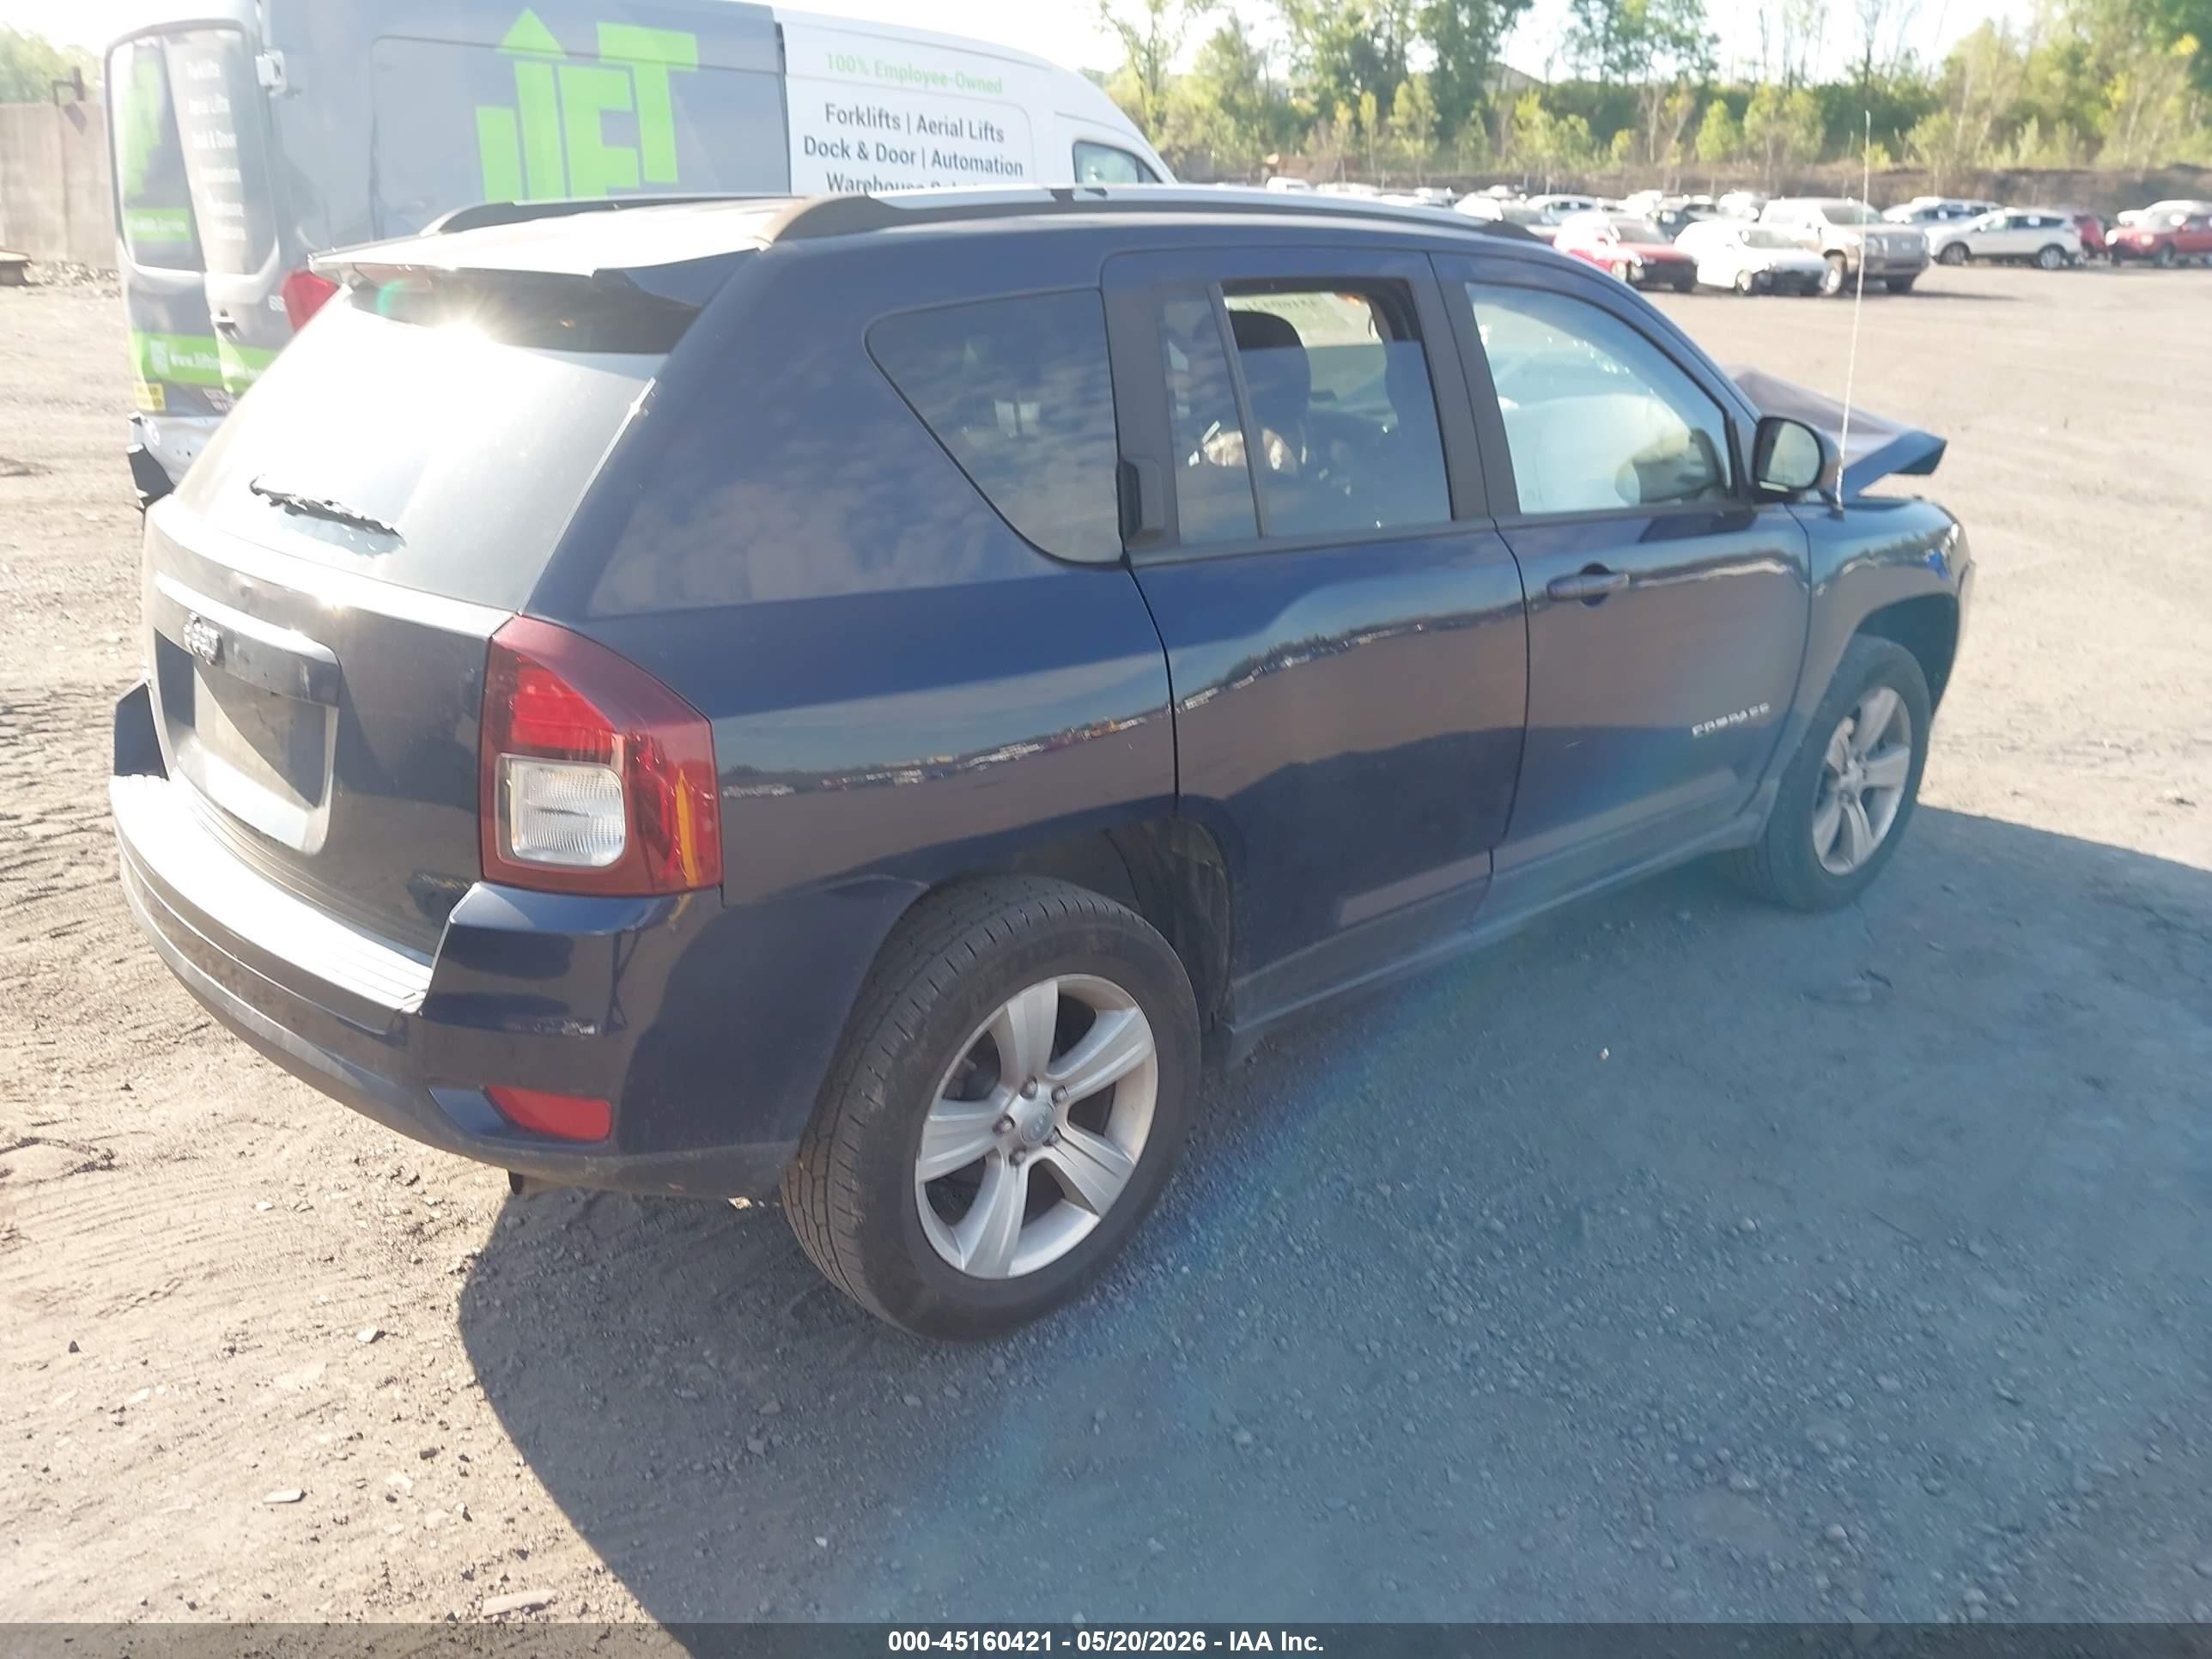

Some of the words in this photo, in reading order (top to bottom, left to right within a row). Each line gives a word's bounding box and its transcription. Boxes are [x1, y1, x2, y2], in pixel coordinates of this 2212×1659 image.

[824, 53, 870, 76] 100%
[874, 59, 1003, 95] Employee-Owned
[824, 102, 901, 131] Forklifts
[916, 113, 963, 139] Aerial
[969, 118, 1005, 143] Lifts
[804, 135, 852, 161] Dock
[857, 140, 869, 161] &
[876, 142, 918, 166] Door
[932, 149, 1023, 178] Automation
